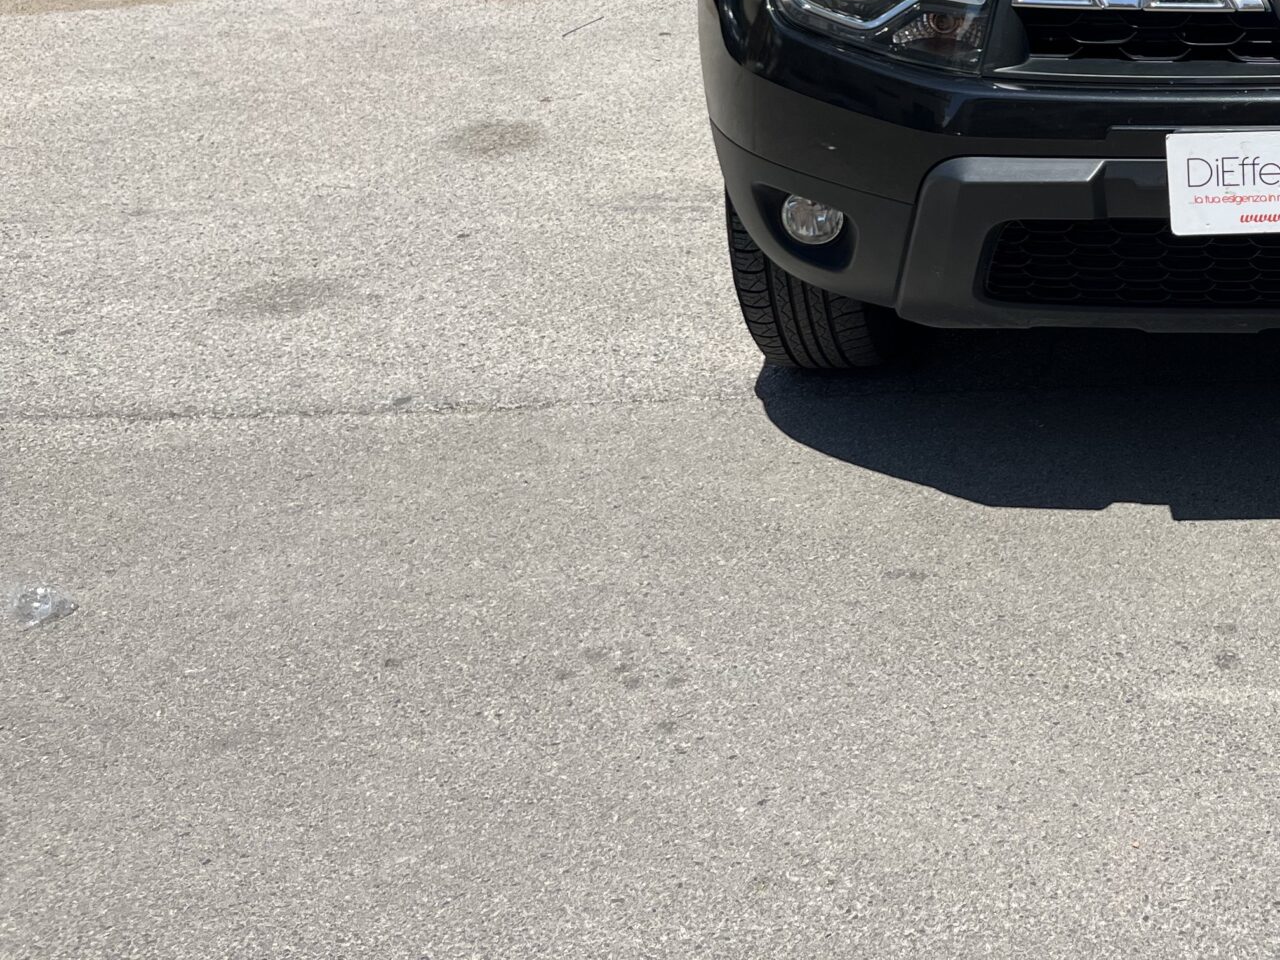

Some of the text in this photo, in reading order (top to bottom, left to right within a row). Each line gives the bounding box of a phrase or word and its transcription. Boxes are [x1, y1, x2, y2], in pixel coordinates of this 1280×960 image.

[1205, 195, 1221, 204] tua
[1221, 194, 1267, 206] esigenza
[1268, 194, 1276, 202] in
